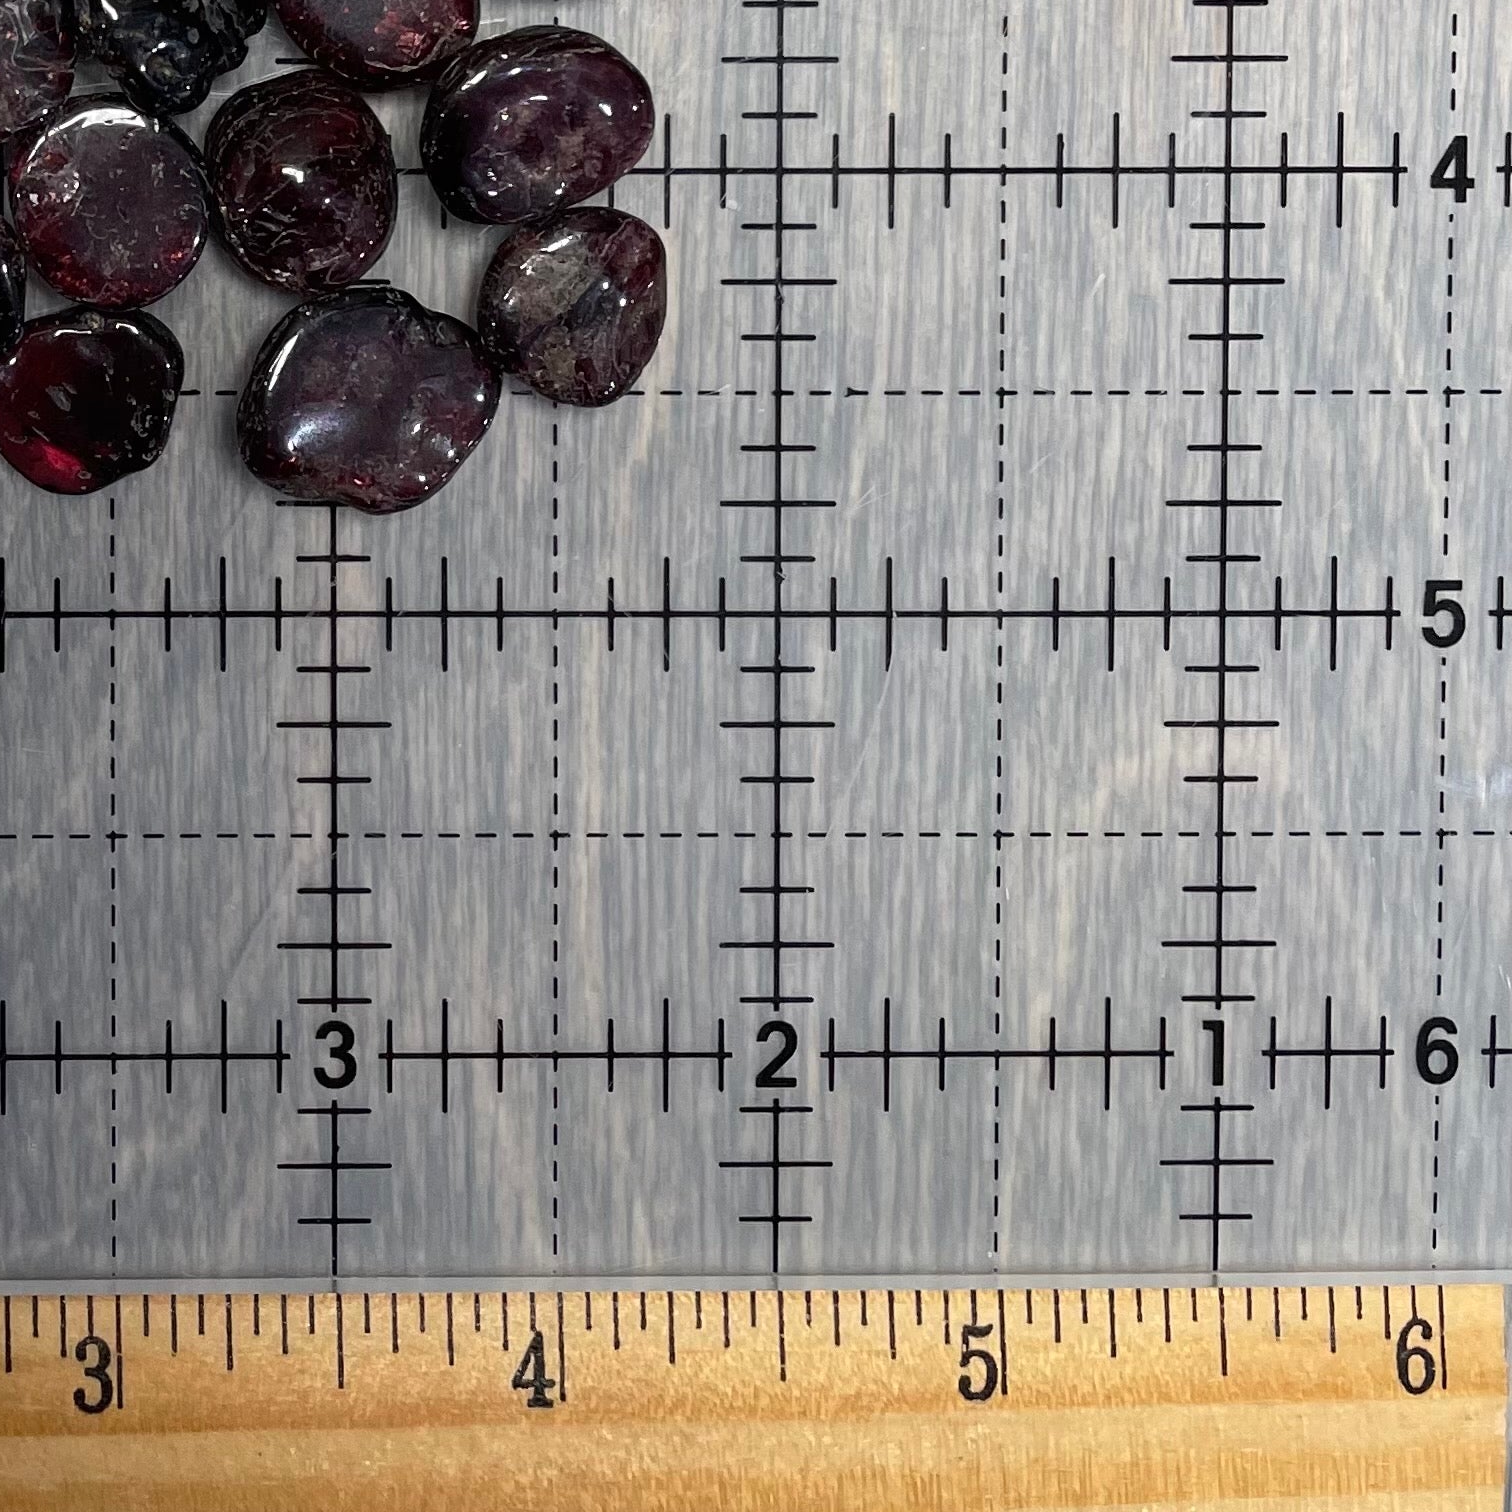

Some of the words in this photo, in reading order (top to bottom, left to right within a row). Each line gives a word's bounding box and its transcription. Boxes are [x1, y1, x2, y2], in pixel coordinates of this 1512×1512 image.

[1430, 136, 1475, 203] 4
[1422, 580, 1465, 648] 5
[314, 1021, 356, 1089] 3
[756, 1021, 797, 1087] 2
[1202, 1020, 1224, 1086] 1
[1416, 1017, 1458, 1084] 6
[74, 1336, 113, 1414] 3
[512, 1332, 554, 1408] 4
[959, 1324, 1000, 1401] 5
[1396, 1319, 1435, 1395] 6
